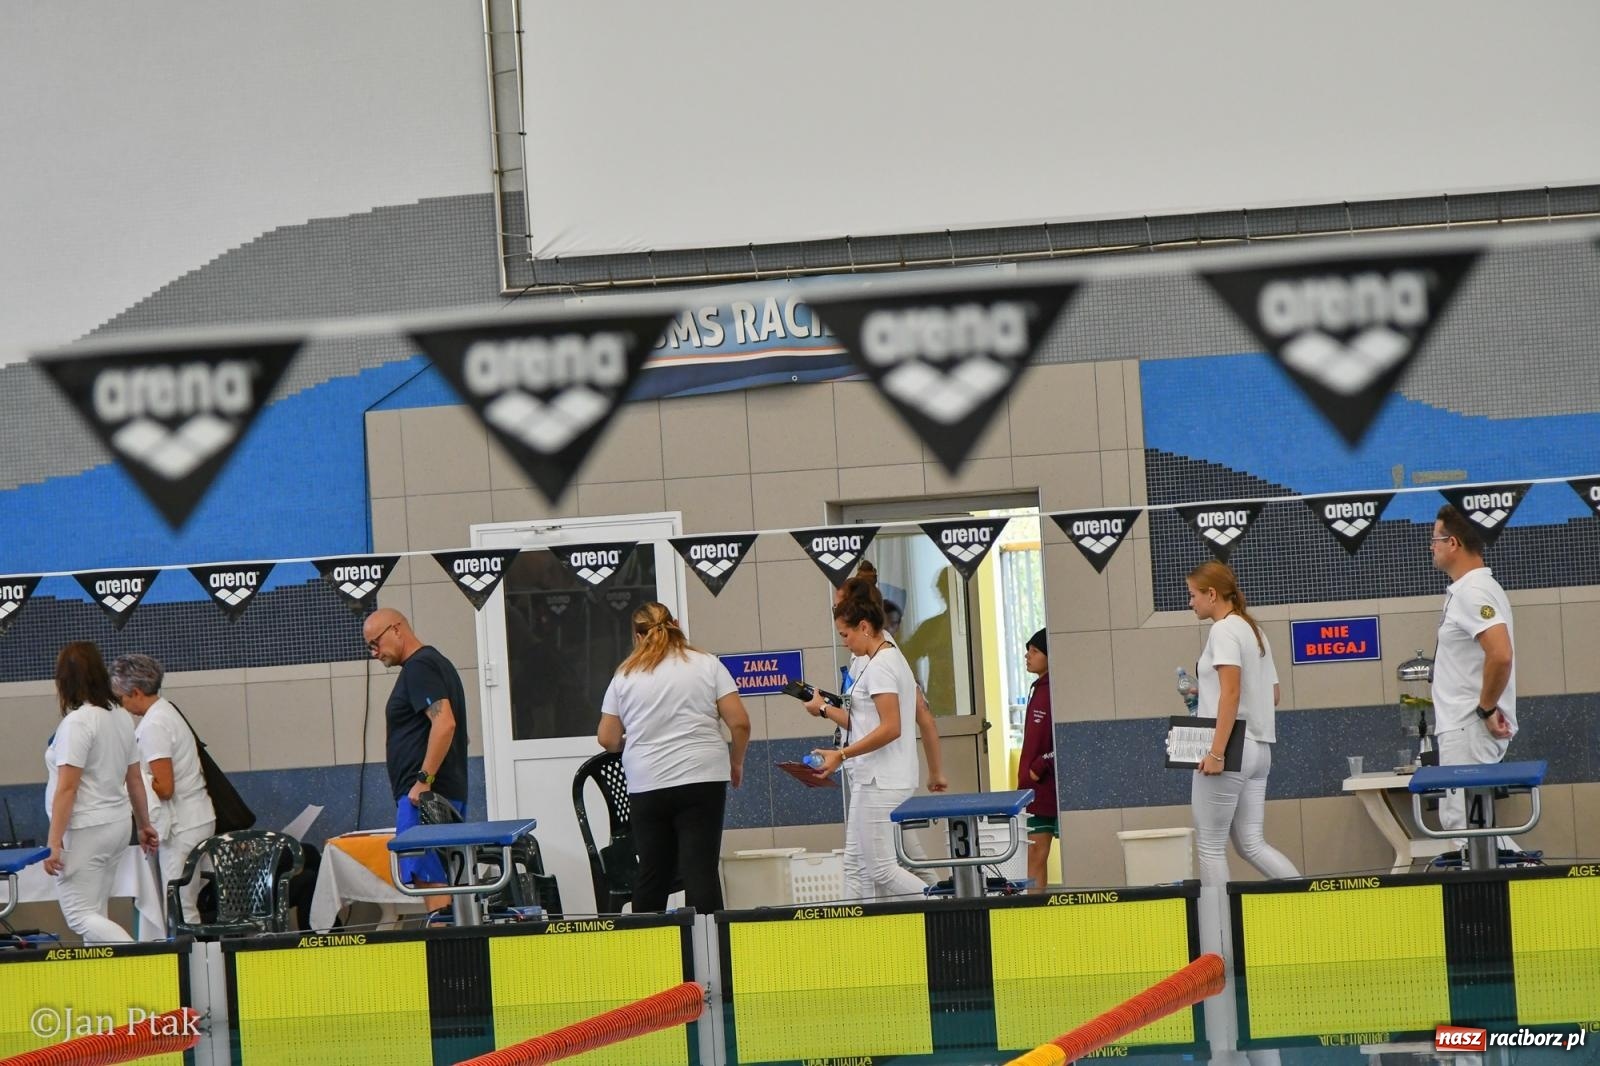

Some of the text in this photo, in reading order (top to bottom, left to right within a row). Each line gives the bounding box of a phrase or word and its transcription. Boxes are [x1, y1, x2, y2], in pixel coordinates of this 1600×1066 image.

[1261, 274, 1424, 333] arena
[655, 295, 835, 348] MS RACI
[864, 305, 1027, 362] arena
[466, 335, 624, 391] arena
[95, 364, 249, 419] arena
[1463, 492, 1513, 511] arena
[1196, 510, 1247, 528] arena
[1324, 502, 1375, 519] arena
[941, 527, 991, 544] arena
[1072, 518, 1123, 536] arena
[689, 543, 739, 560] arena
[811, 535, 861, 553] arena
[453, 557, 502, 574] arena
[570, 550, 619, 567] arena
[209, 571, 257, 588] arena
[333, 565, 382, 582] arena
[95, 579, 142, 595] arena
[1321, 625, 1349, 639] NIE
[1305, 640, 1366, 656] BIEGAJ
[743, 659, 779, 673] ZAKAZ
[735, 674, 789, 688] SKAKANIA
[1470, 794, 1486, 828] 4
[953, 820, 970, 858] 3
[451, 850, 469, 886] 2
